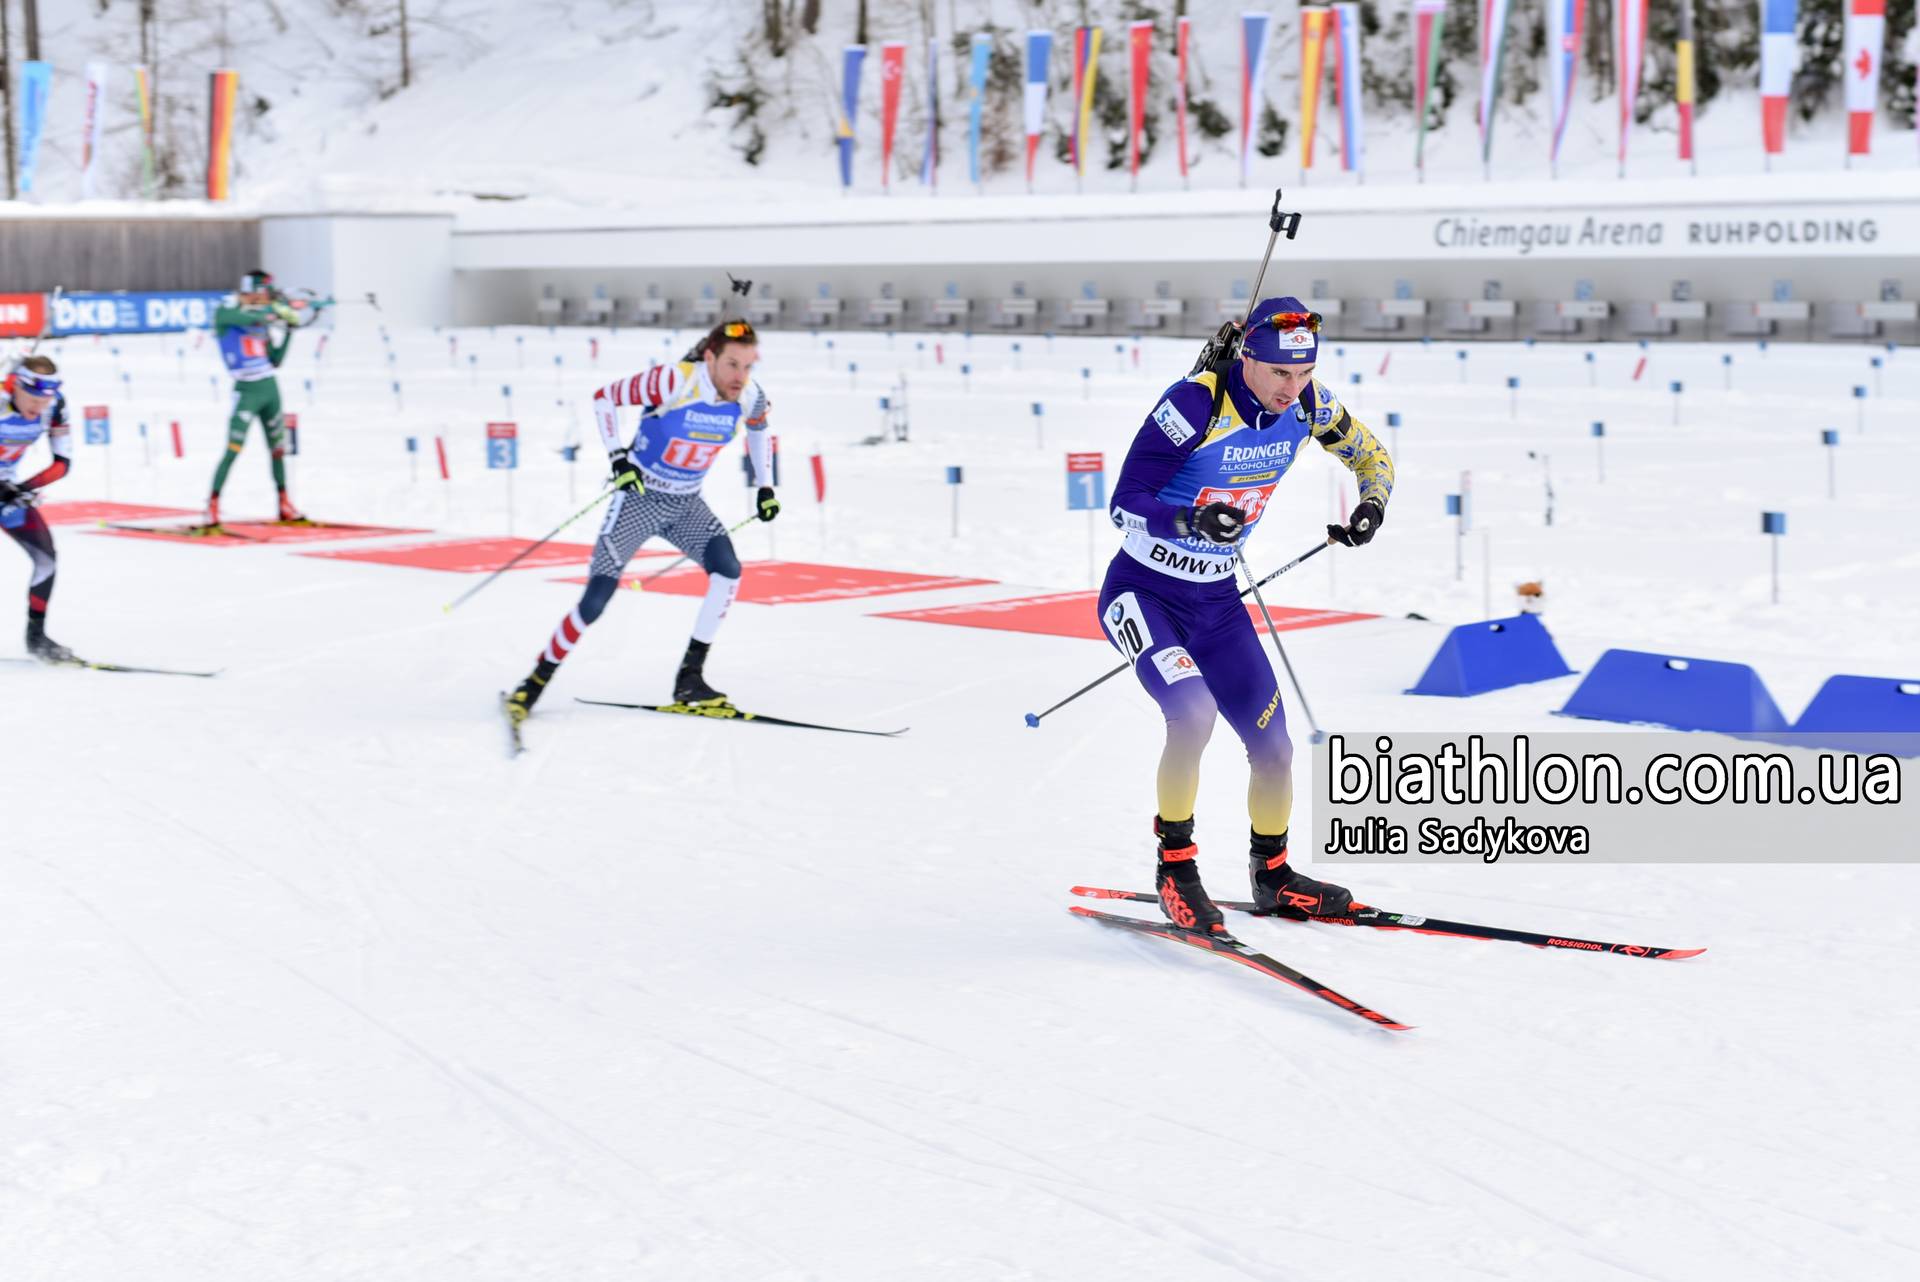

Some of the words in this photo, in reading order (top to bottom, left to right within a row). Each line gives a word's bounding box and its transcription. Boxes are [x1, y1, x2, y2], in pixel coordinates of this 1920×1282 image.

[1434, 218, 1571, 254] Chiemgau
[1578, 216, 1665, 245] Arena
[1687, 219, 1879, 244] RUHPOLDING
[55, 299, 117, 328] DKB
[146, 299, 206, 327] DKB
[91, 421, 106, 442] 5
[494, 439, 512, 469] 3
[672, 444, 714, 467] 15
[1219, 457, 1290, 472] ALKOHOLFREI
[1222, 441, 1292, 462] ERDINGER
[1079, 474, 1095, 508] 1
[1149, 544, 1211, 575] BMW
[1118, 618, 1143, 666] 20
[1546, 937, 1604, 953] ROSSIGNOL
